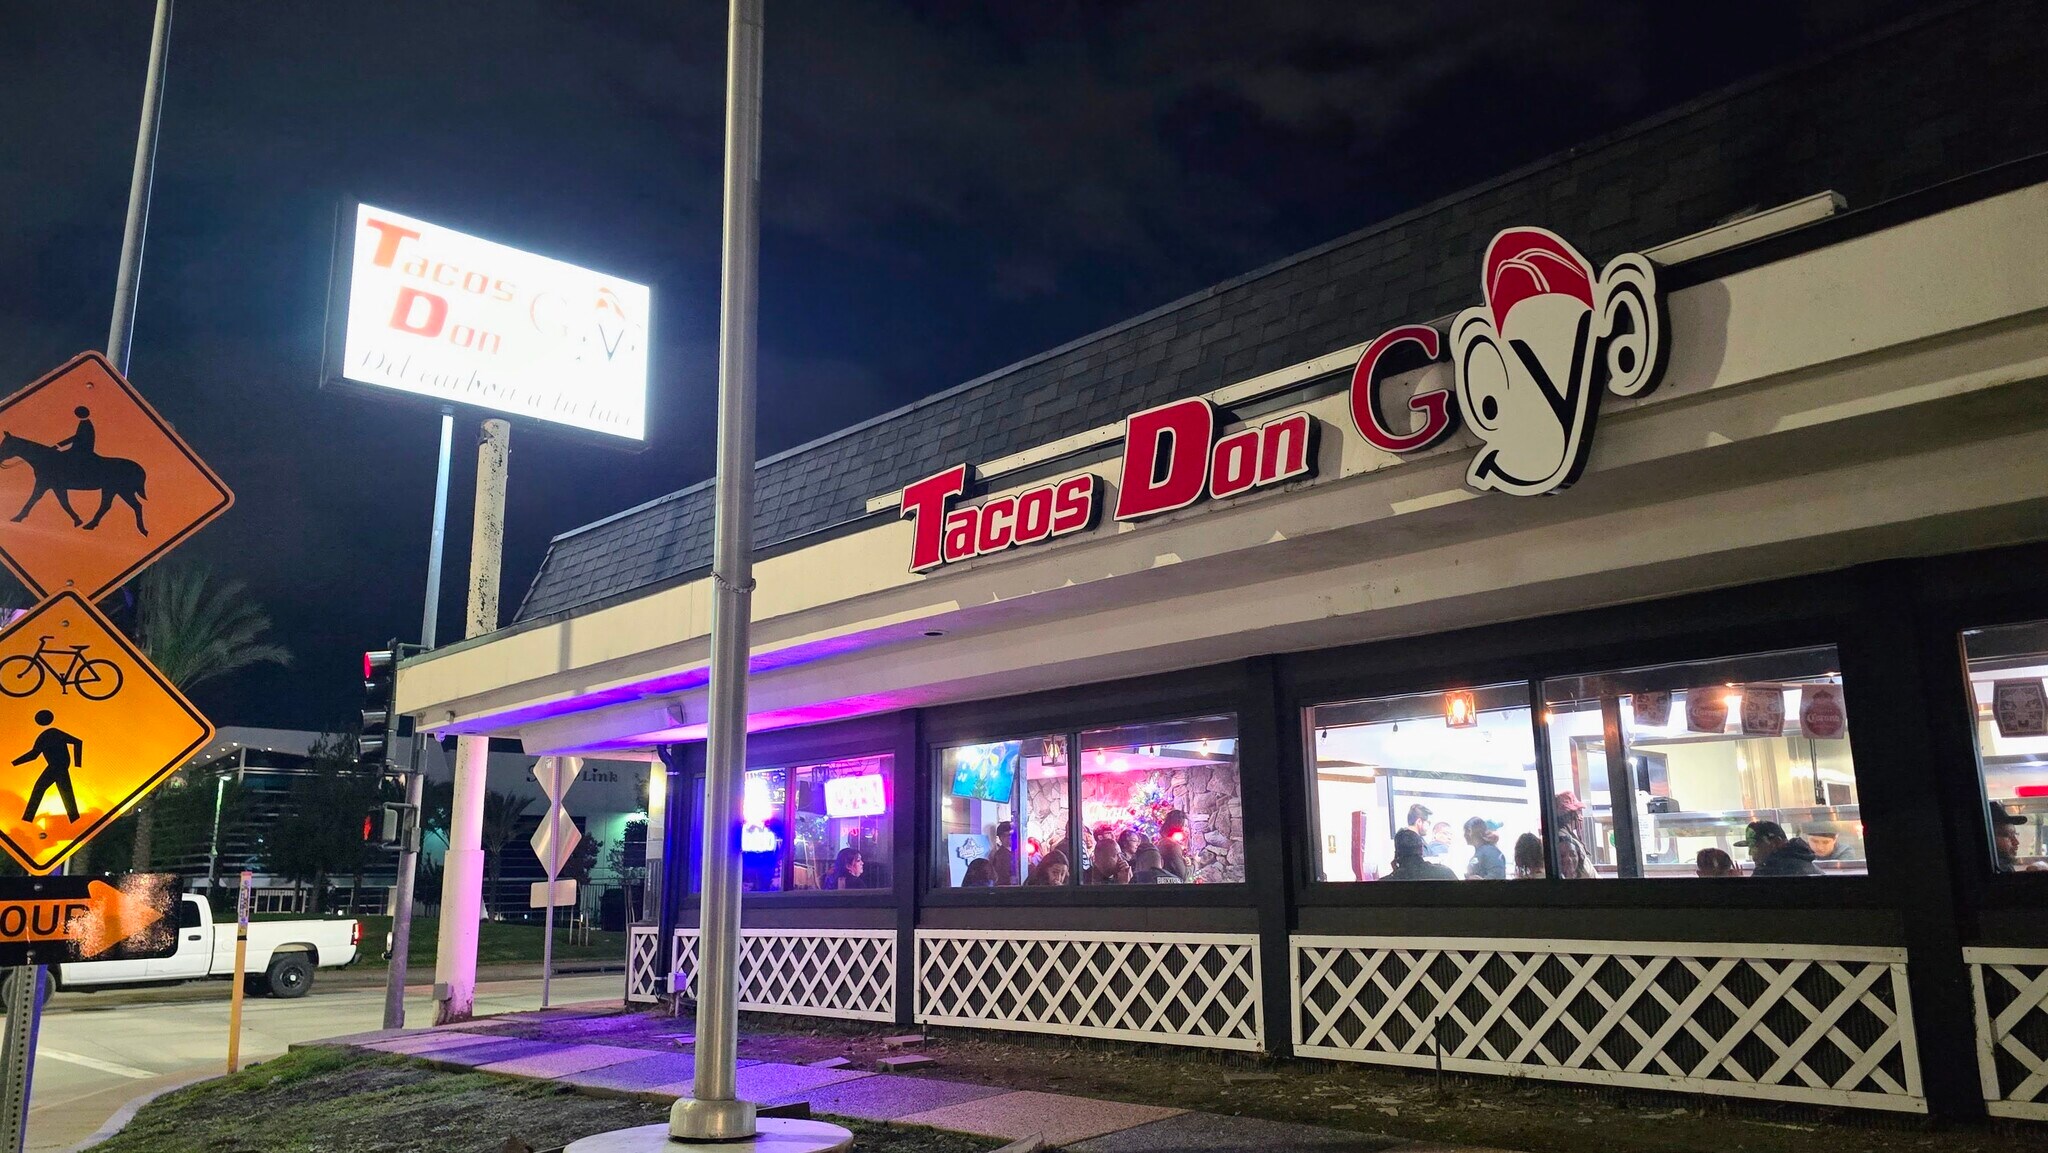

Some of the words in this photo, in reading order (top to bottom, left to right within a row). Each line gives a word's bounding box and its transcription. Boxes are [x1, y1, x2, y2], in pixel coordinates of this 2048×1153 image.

[366, 217, 518, 302] Tacos
[389, 286, 502, 355] Don
[900, 463, 1094, 574] Tacos
[1113, 395, 1312, 522] Don
[582, 767, 618, 783] Link
